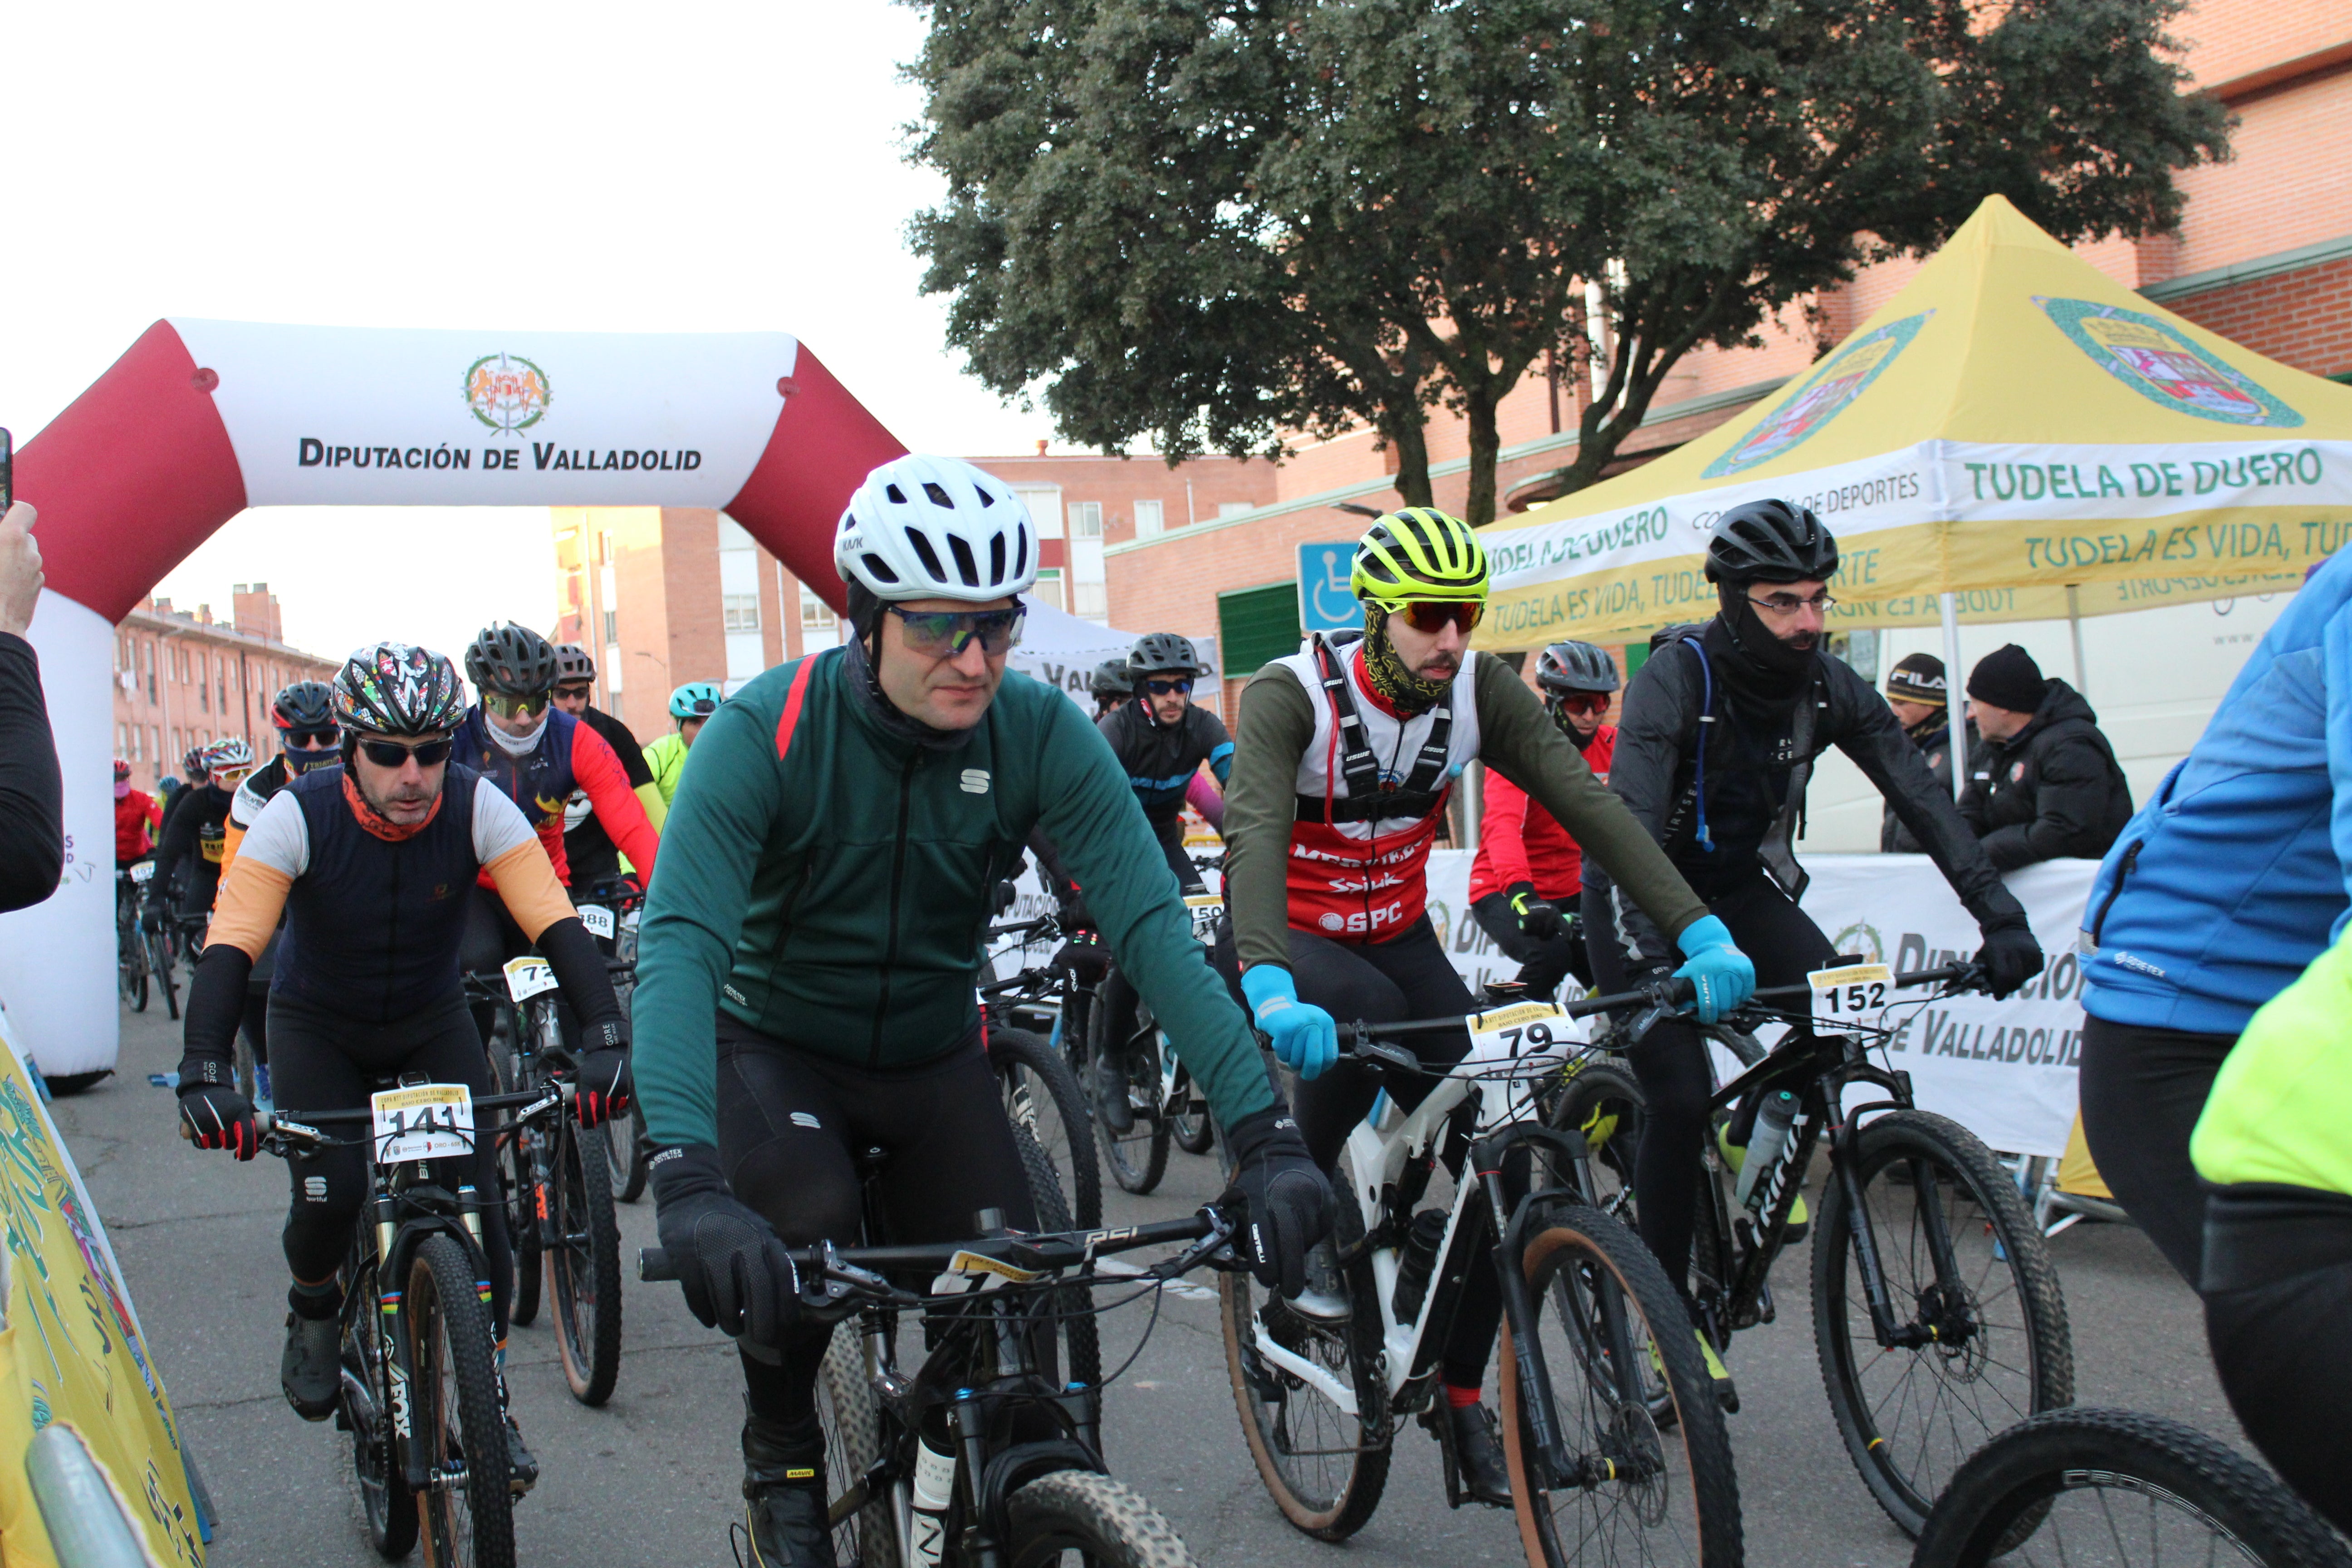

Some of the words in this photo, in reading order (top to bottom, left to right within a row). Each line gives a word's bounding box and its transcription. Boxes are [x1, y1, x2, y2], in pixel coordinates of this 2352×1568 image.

[299, 438, 470, 470] DIPUTACIÓN
[482, 449, 519, 470] DE
[532, 443, 702, 471] VALLADOLID
[1965, 462, 2125, 501] TUDELA
[2129, 462, 2183, 498] DE
[2191, 447, 2323, 495] DUERO
[1827, 472, 1920, 514] DEPORTES
[2025, 529, 2158, 569] TUDELA
[2162, 525, 2199, 560] ES
[2206, 522, 2291, 562] VIDA,
[1494, 593, 1564, 633] TUDELA
[1567, 588, 1589, 621] ES
[1595, 579, 1646, 616] VIDA,
[1890, 670, 1947, 689] FILA
[1346, 750, 1371, 762] USWE
[1346, 901, 1403, 932] SPC
[1825, 982, 1885, 1014] 152
[603, 1023, 614, 1046] GORE
[1514, 1016, 1529, 1024] CERO
[1499, 1023, 1553, 1059] 79
[403, 1090, 428, 1100] DIPUTACIÓN
[389, 1105, 457, 1139] 141
[1251, 1223, 1267, 1264] CASTELLI
[390, 1381, 412, 1441] FOX
